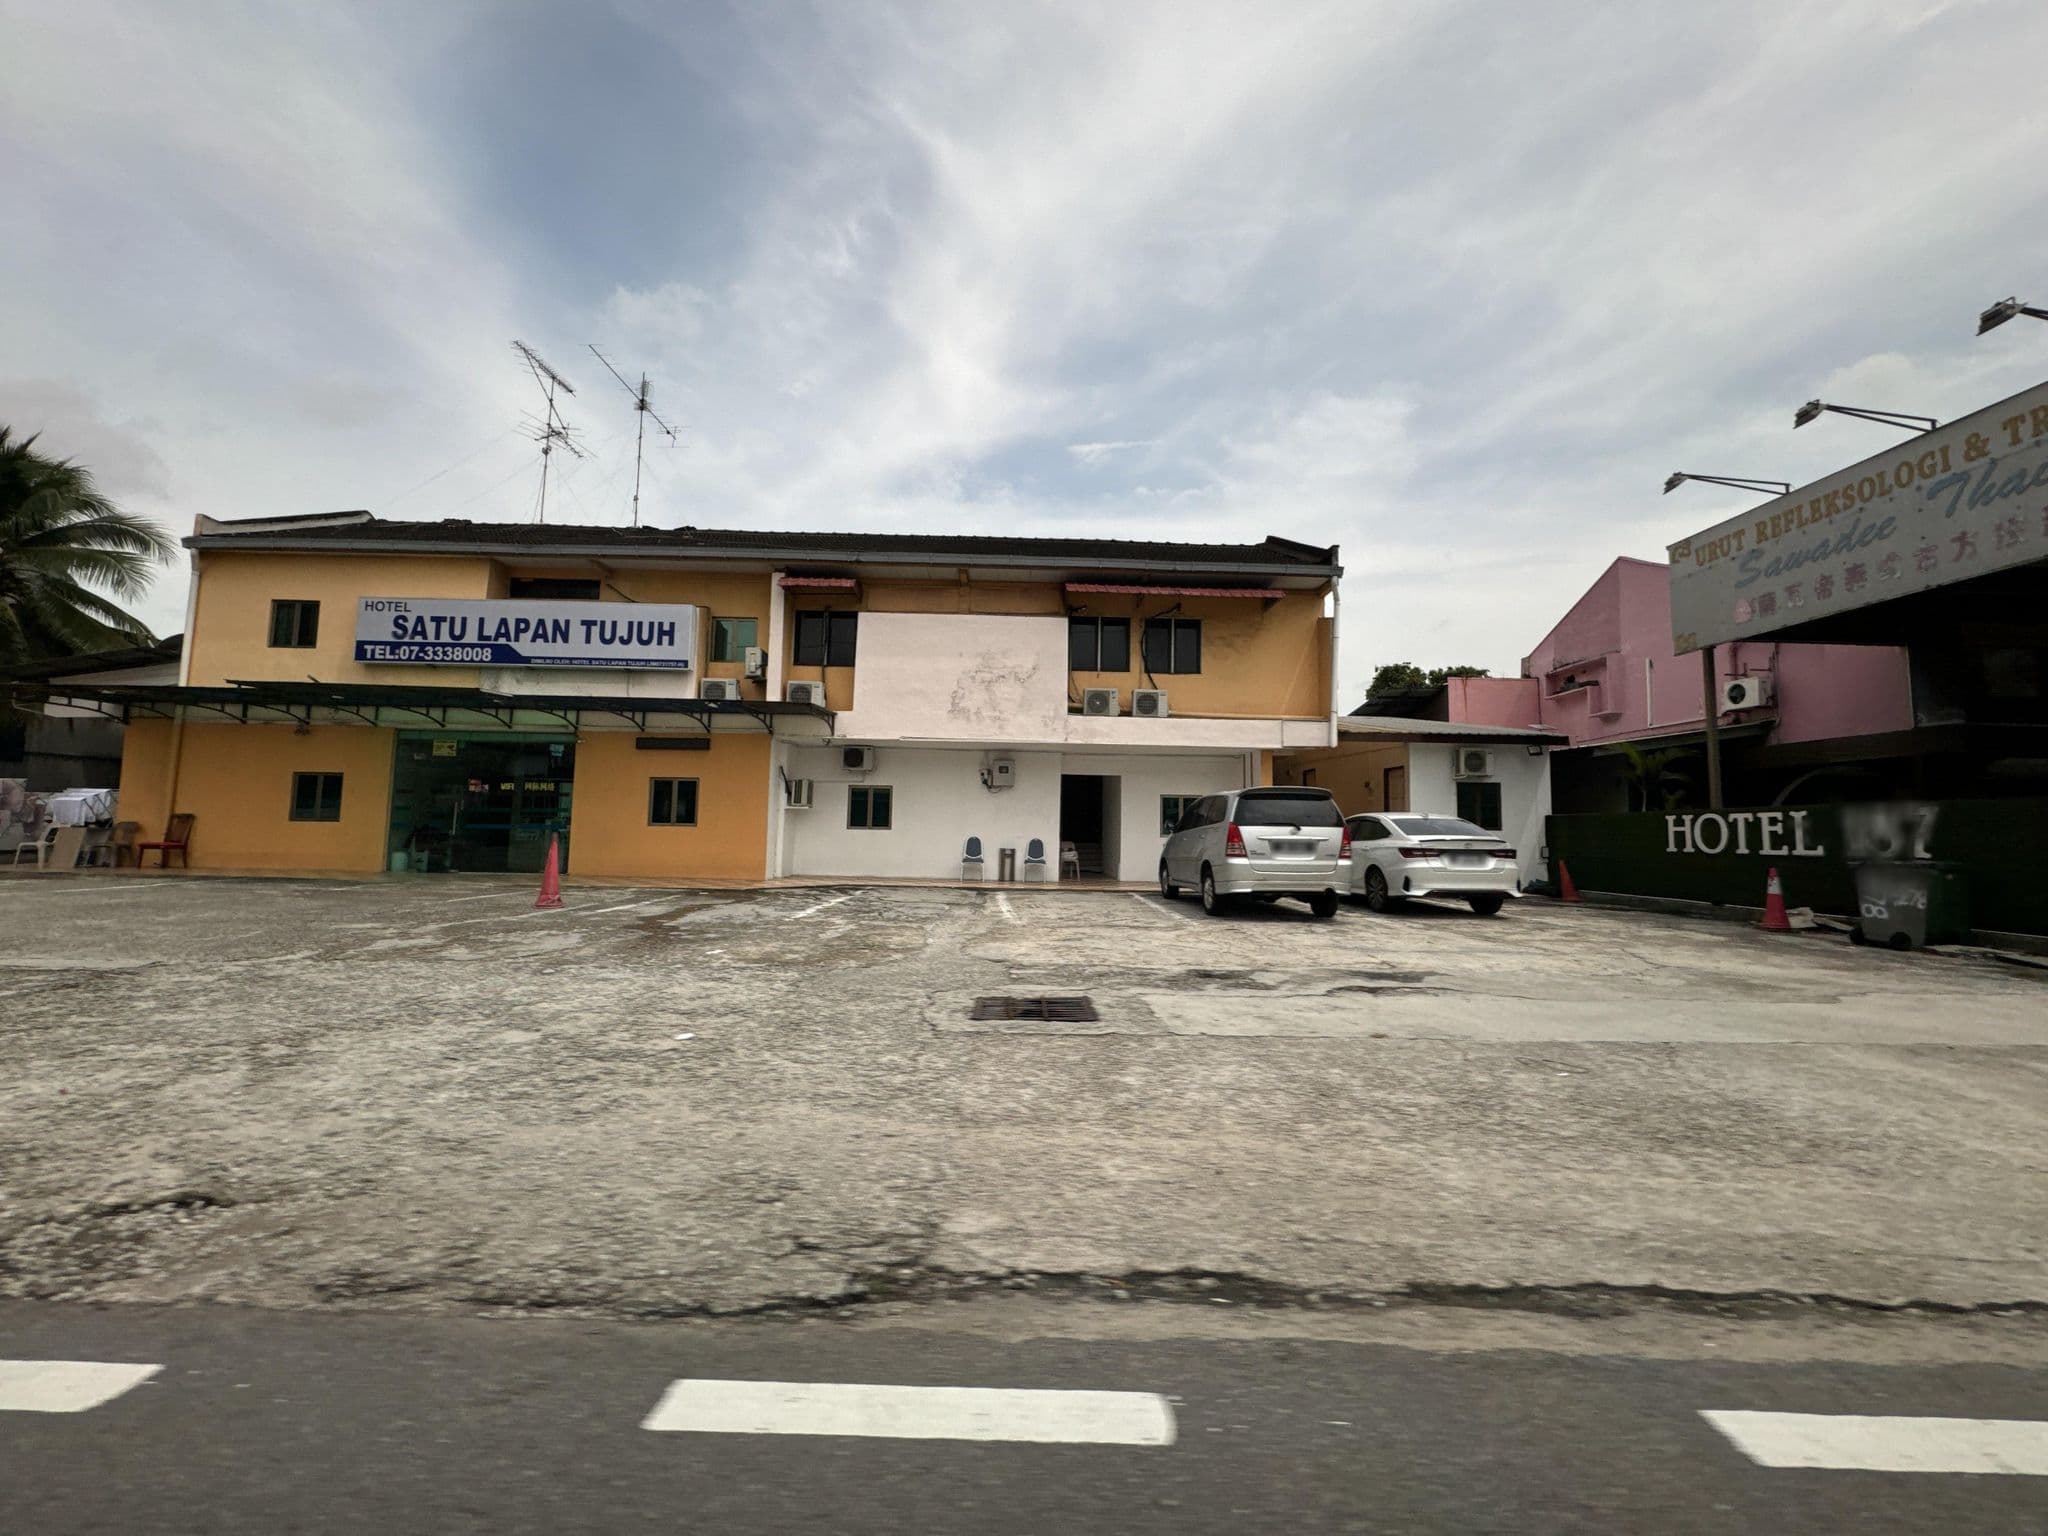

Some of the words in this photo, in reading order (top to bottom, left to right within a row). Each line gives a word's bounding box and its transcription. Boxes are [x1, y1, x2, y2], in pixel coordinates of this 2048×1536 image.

[1694, 527, 1746, 567] URUT
[1754, 444, 1952, 545] REFLEKSOLOGI
[1962, 431, 1991, 463] &
[1734, 515, 1896, 589] Sawadee
[364, 600, 412, 613] HOTEL
[391, 614, 467, 642] SATU
[477, 616, 571, 644] LAPAN
[580, 619, 676, 647] TUJUH
[363, 644, 492, 662] TEL:07-3338008
[1665, 811, 1824, 856] HOTEL
